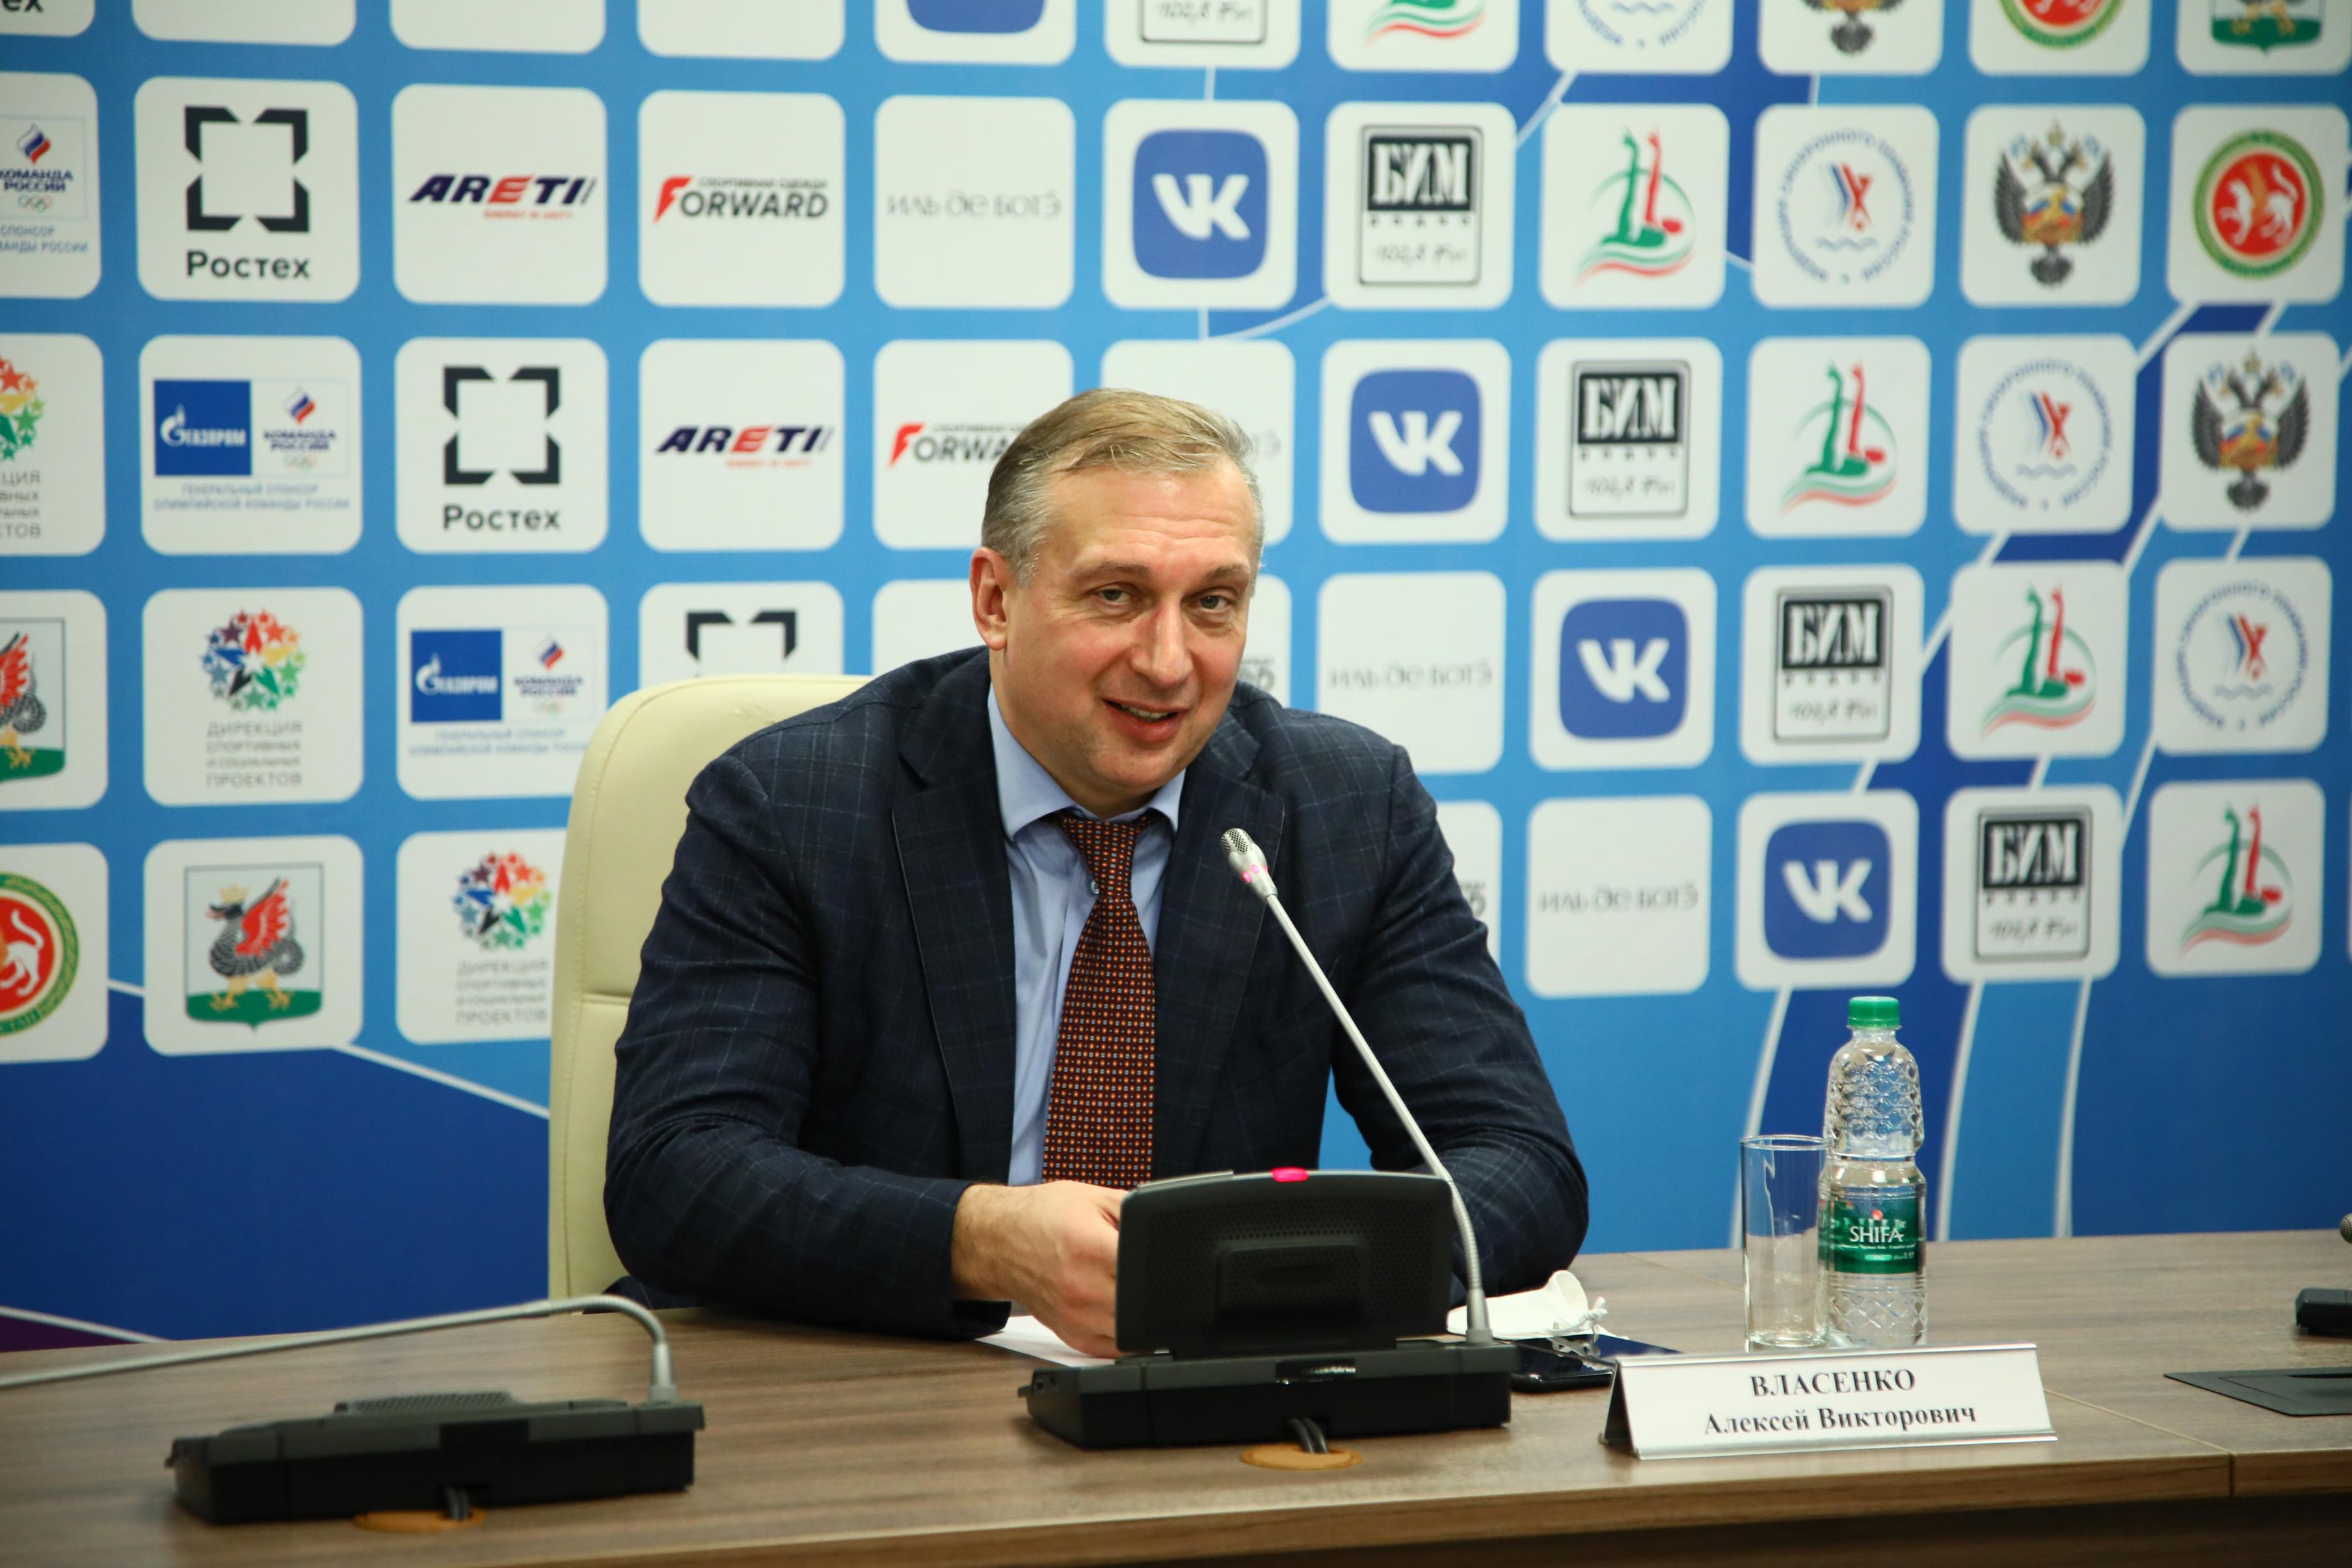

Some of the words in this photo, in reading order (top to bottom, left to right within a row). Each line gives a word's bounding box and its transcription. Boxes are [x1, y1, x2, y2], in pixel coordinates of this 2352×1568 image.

[408, 174, 585, 204] ARETI
[1371, 142, 1470, 205] БИМ
[653, 176, 828, 223] FORWARD
[1152, 173, 1251, 240] VK
[186, 250, 310, 279] Ростех
[1583, 378, 1676, 439] БИМ
[656, 425, 822, 453] ARETI
[888, 422, 1009, 470] FORWA
[1369, 410, 1464, 476] VK
[443, 505, 561, 531] Ростех
[1789, 604, 1879, 664] БИМ
[1579, 637, 1671, 703] VK
[1990, 823, 2079, 884] БИМ
[1782, 858, 1873, 924] VK
[1849, 1226, 1904, 1243] SHIFA
[1750, 1368, 1916, 1397] ВЛАСЕНКО
[1705, 1409, 1811, 1435] Алексей
[1817, 1407, 1977, 1432] Викторович
